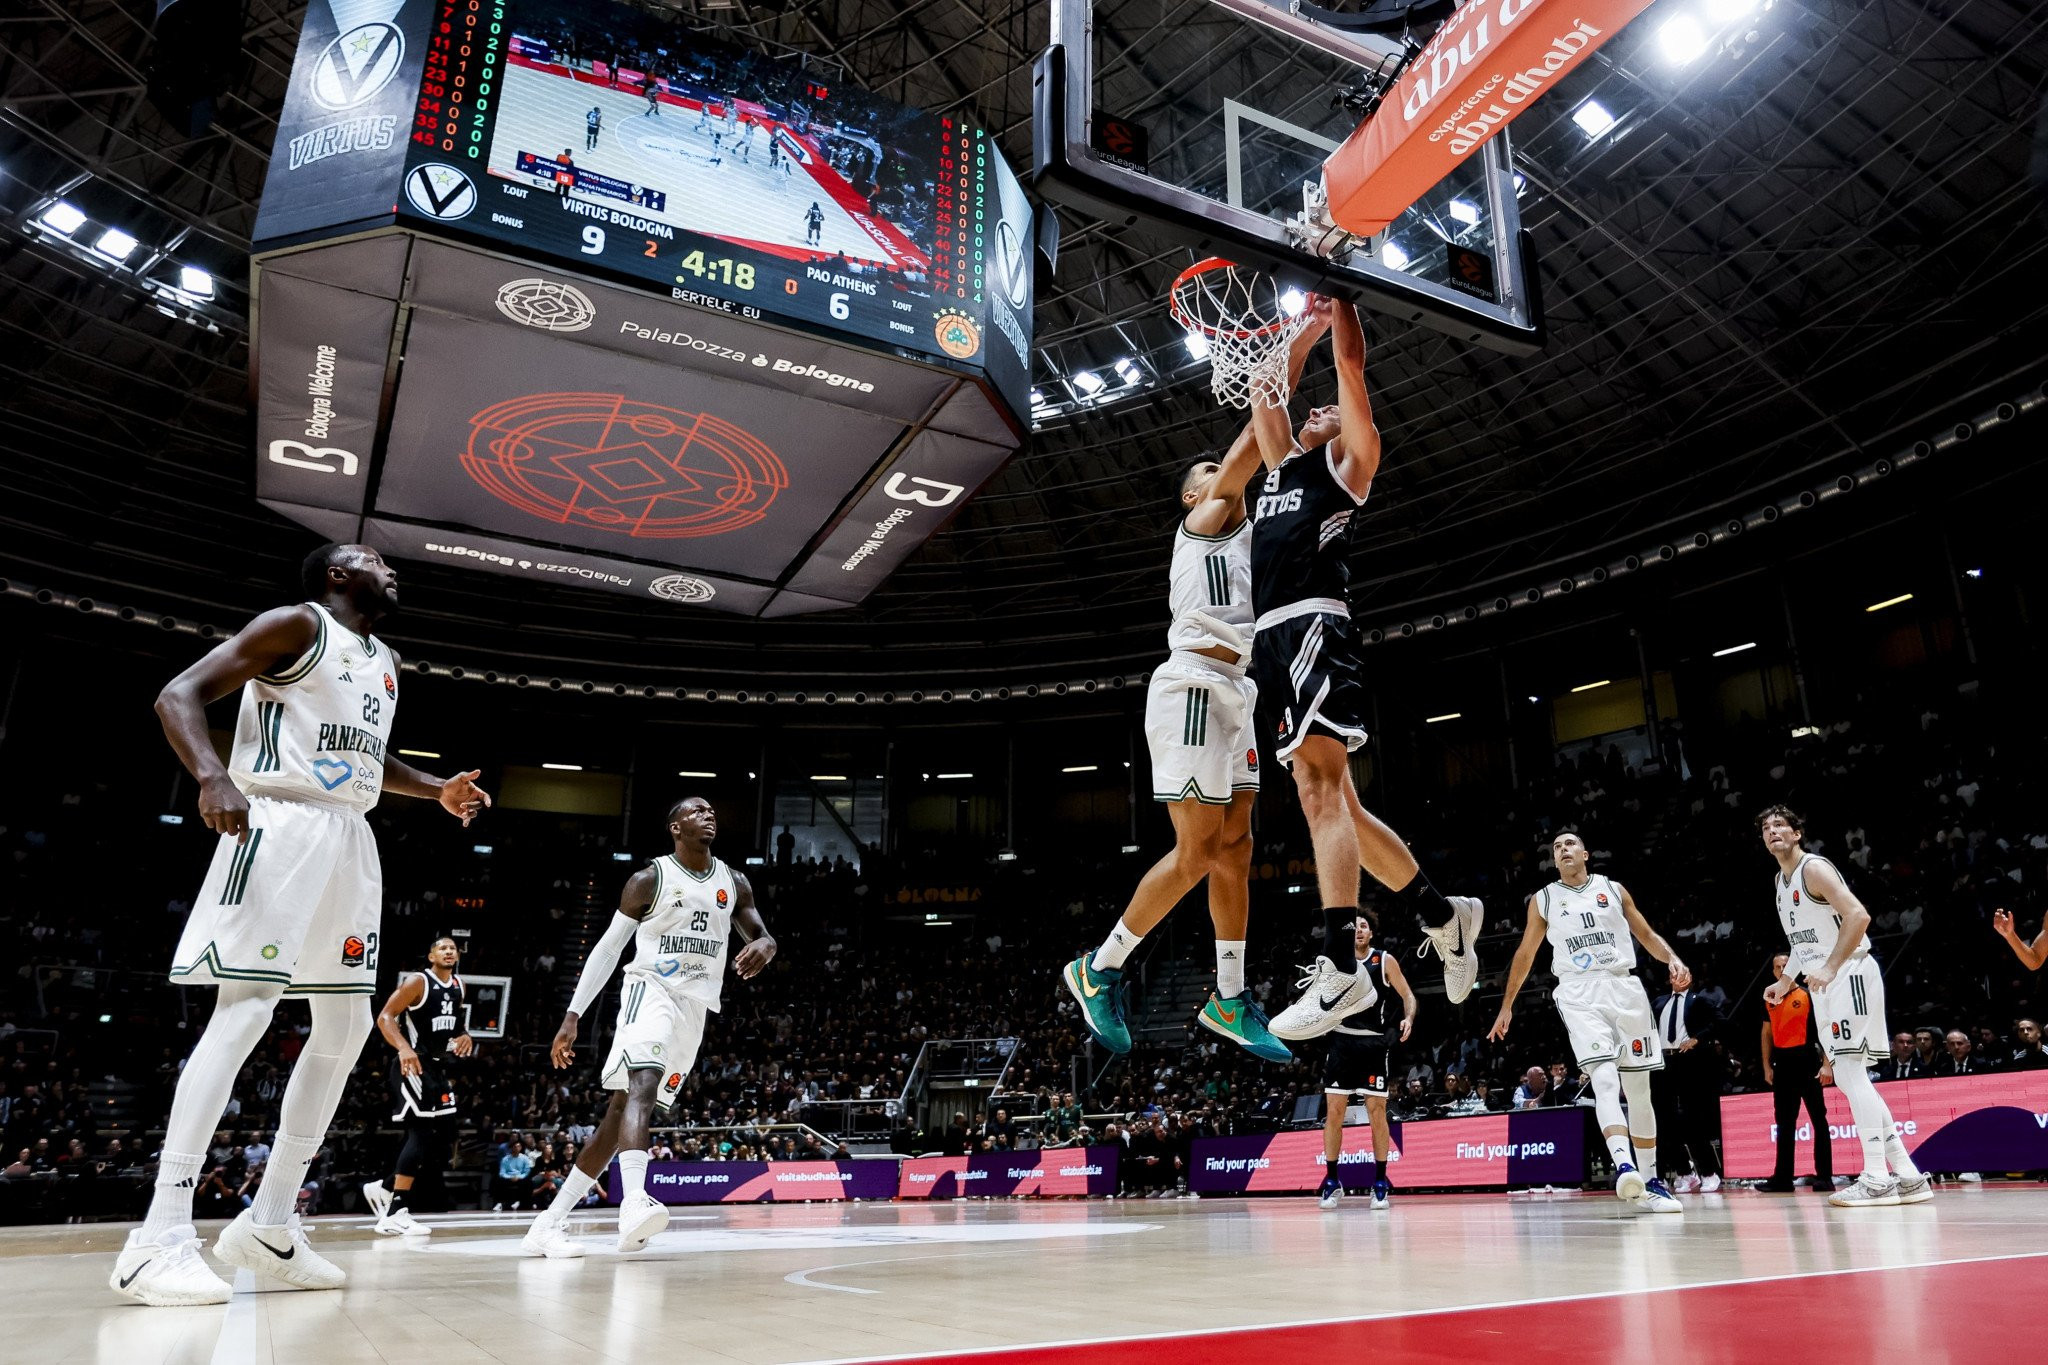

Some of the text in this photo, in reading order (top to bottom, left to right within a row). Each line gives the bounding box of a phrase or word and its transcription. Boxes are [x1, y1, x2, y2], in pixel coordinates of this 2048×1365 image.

[443, 6, 501, 34] 7 0 0
[468, 0, 503, 19] 0 3
[434, 36, 496, 65] 11 0 0
[465, 30, 472, 42] 1
[487, 38, 499, 50] 2
[428, 51, 493, 80] 21 1 0
[1402, 12, 1491, 122] abu
[425, 66, 491, 95] 23 0 0
[422, 82, 488, 111] 30 0 0
[1428, 73, 1505, 143] experience
[419, 98, 485, 127] 34 0 2
[416, 113, 482, 142] 35 0 0
[942, 117, 984, 139] N F P
[1449, 102, 1511, 156] abu
[289, 114, 398, 171] VIRTUS
[412, 131, 479, 159] 45 0 0
[942, 132, 985, 154] 0 0 0
[942, 145, 985, 167] 6 0 0
[578, 170, 600, 181] VIRTUS
[940, 157, 985, 181] 10 0 2
[502, 183, 529, 199] T.OUT
[938, 170, 984, 194] 17 0 0
[937, 183, 984, 208] 22 0 2
[491, 212, 524, 230] BONUS
[561, 196, 675, 241] VIRTUS BOLOGNA
[936, 197, 984, 221] 24 0 0
[936, 211, 984, 234] 25 0 0
[580, 225, 606, 256] 9
[935, 224, 983, 248] 27 0 0
[644, 239, 659, 259] 2
[935, 239, 983, 261] 40 0 0
[681, 249, 756, 292] 4:18
[935, 253, 983, 275] 41 0 0
[784, 278, 799, 296] 0
[806, 266, 877, 297] PAO ATHENS
[934, 267, 982, 290] 44 0 0
[1451, 276, 1494, 298] EuroLeague
[935, 280, 982, 304] 77 0 4
[829, 292, 851, 321] 6
[891, 299, 913, 313] T.OUT
[889, 320, 915, 335] BONUS
[619, 320, 876, 394] PalaDozza è Bologna
[304, 344, 337, 440] Bologna Welcome
[1263, 468, 1281, 493] 9
[1254, 488, 1304, 521] RTUS
[841, 507, 914, 572] Bologna Welcome
[424, 542, 515, 568] Bologna
[536, 561, 633, 588] PalaDozza
[362, 693, 381, 727] 22
[1284, 706, 1294, 735] 9
[316, 722, 386, 768] PANATHINA
[690, 910, 710, 933] 25
[1579, 911, 1596, 929] 10
[1789, 910, 1796, 928] 6
[440, 1000, 454, 1015] 34
[1840, 1019, 1852, 1040] 6
[1376, 1075, 1385, 1091] 6
[1456, 1140, 1555, 1161] Find your pace
[775, 1171, 853, 1183] visitabudhabi.ae
[1007, 1167, 1044, 1180] Find your pace
[1206, 1157, 1270, 1173] Find your pace
[653, 1173, 730, 1187] Find your pace
